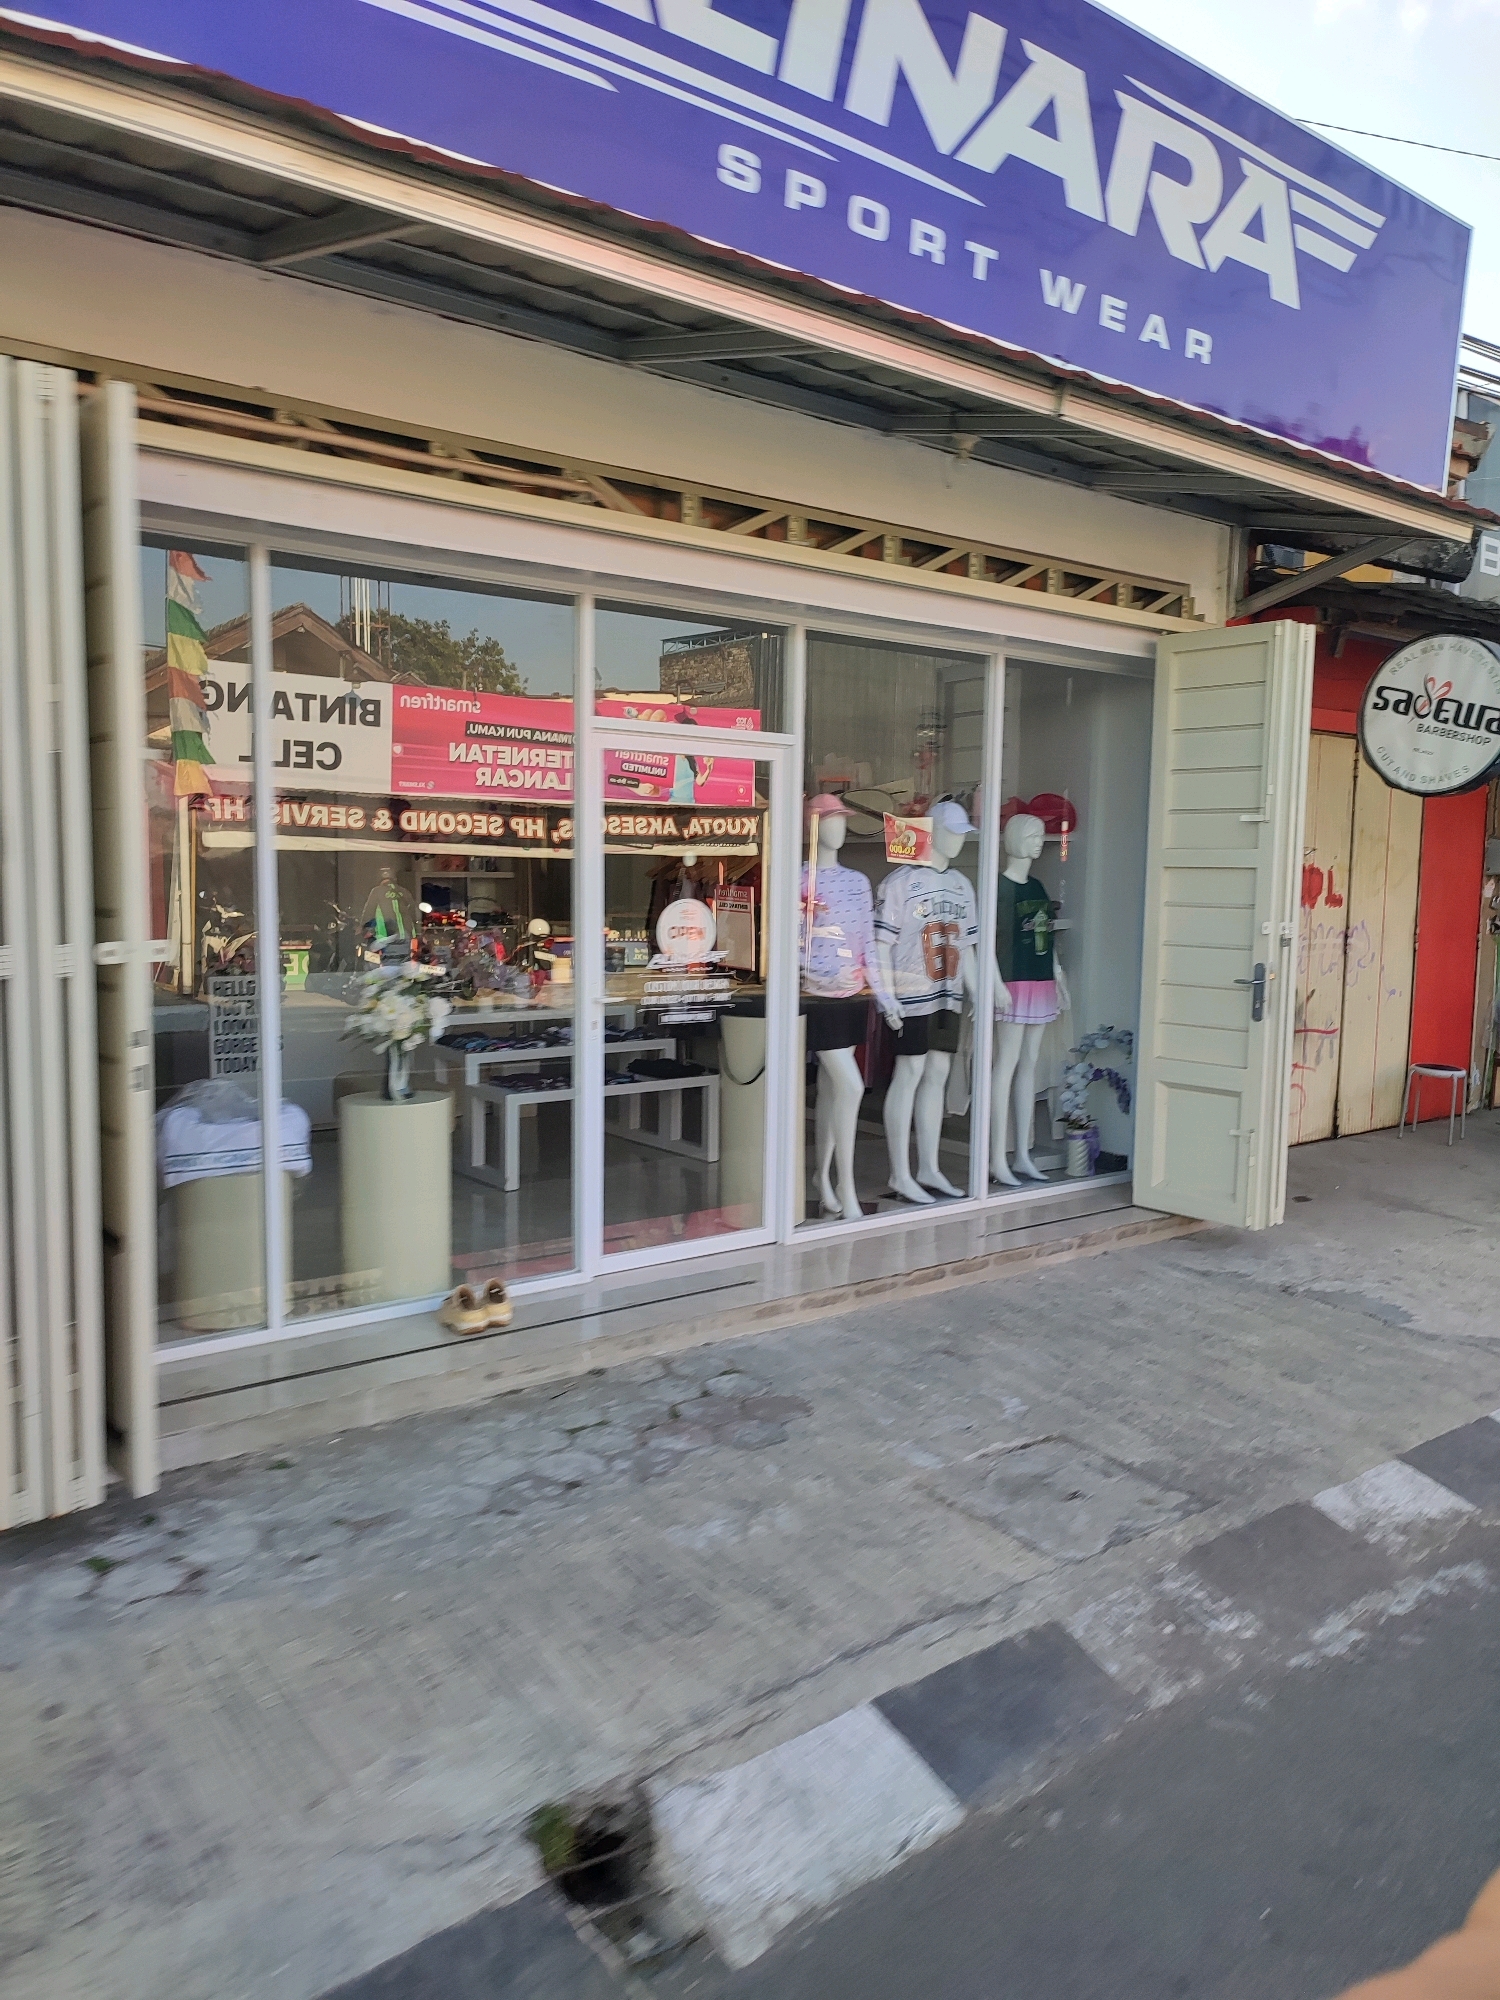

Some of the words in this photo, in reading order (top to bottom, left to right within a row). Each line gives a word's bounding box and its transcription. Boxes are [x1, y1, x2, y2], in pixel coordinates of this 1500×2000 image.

[717, 143, 999, 283] SPORT
[1040, 268, 1214, 366] WEAR
[1416, 723, 1492, 746] BARBERSHOP
[1421, 764, 1471, 784] SHAVES
